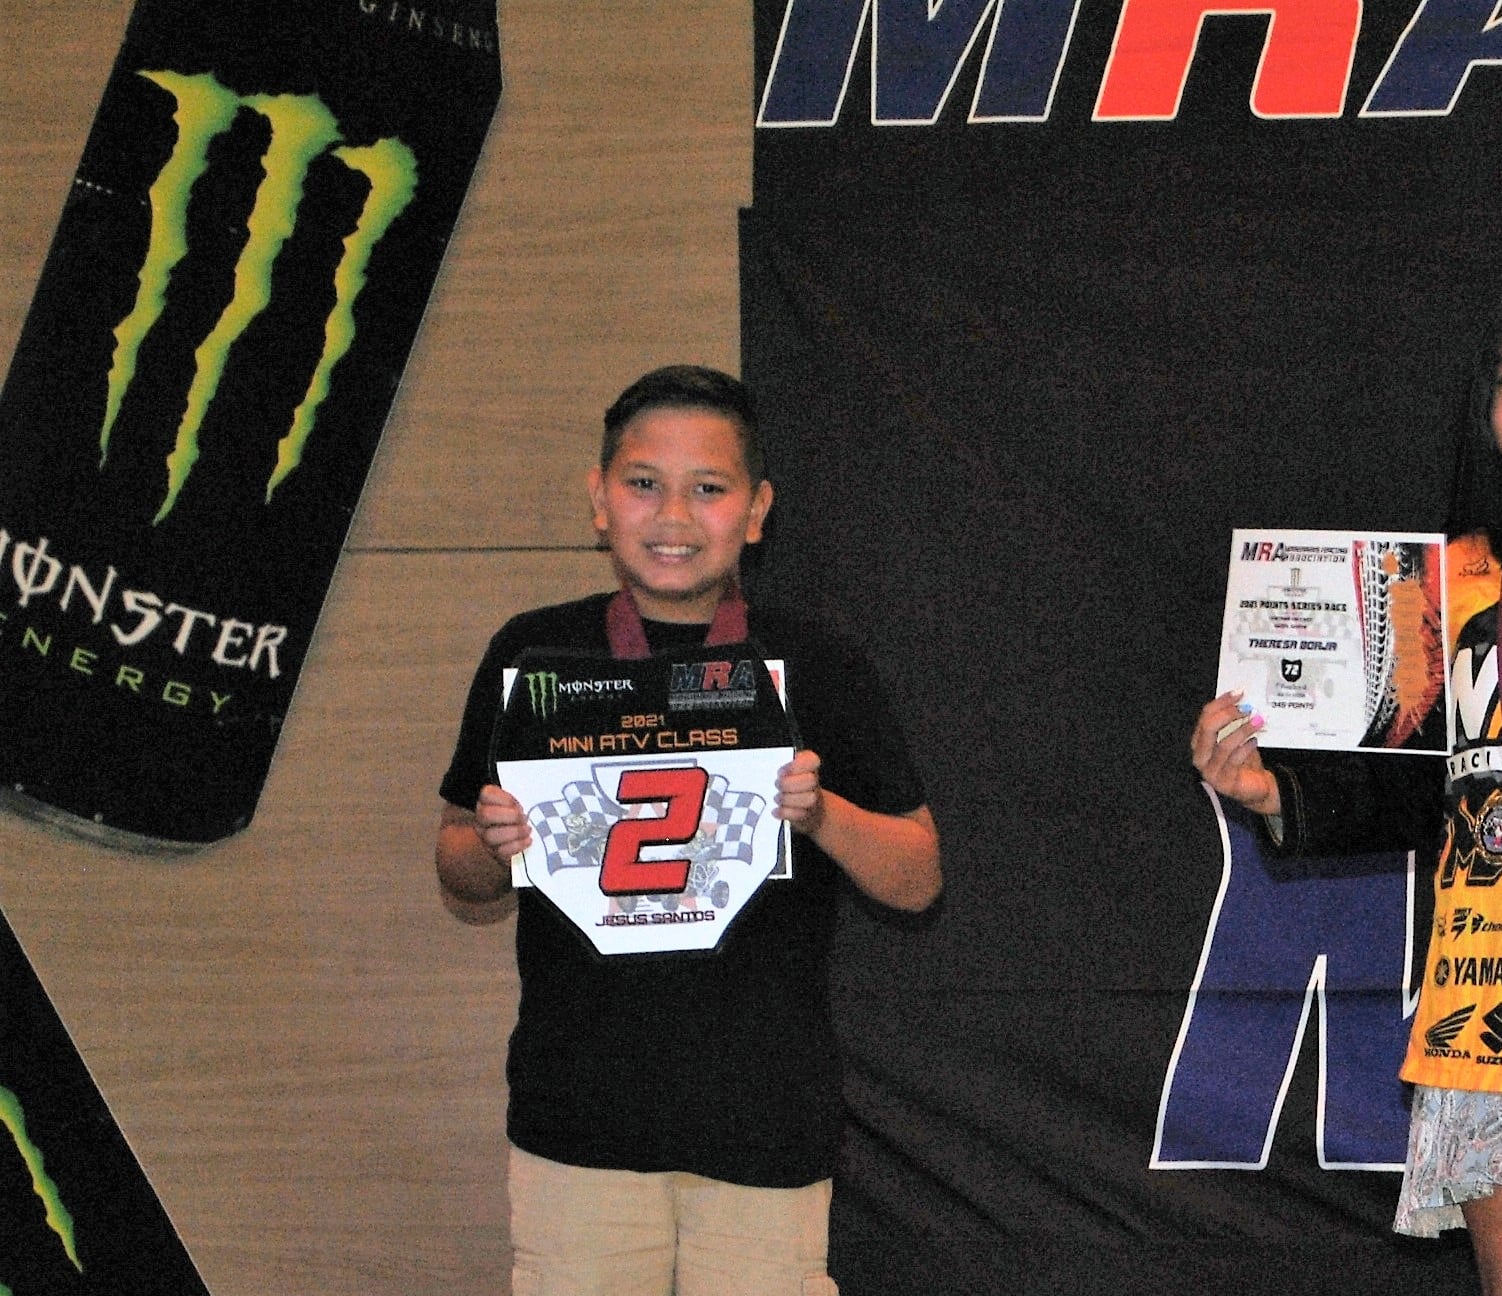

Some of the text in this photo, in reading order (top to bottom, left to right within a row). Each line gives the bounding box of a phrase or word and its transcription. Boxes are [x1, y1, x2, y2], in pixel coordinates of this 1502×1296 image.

[0, 529, 287, 679] ONSTER
[1249, 638, 1338, 651] THERESA BORJA
[0, 608, 231, 714] NERGY
[1284, 664, 1300, 676] 72
[670, 660, 756, 692] MRA
[620, 715, 666, 729] 2021
[550, 728, 738, 753] MINI ATV CLASS
[599, 766, 709, 896] 2
[595, 910, 716, 927] JESUS SANTOS
[1423, 1047, 1472, 1060] HONDA
